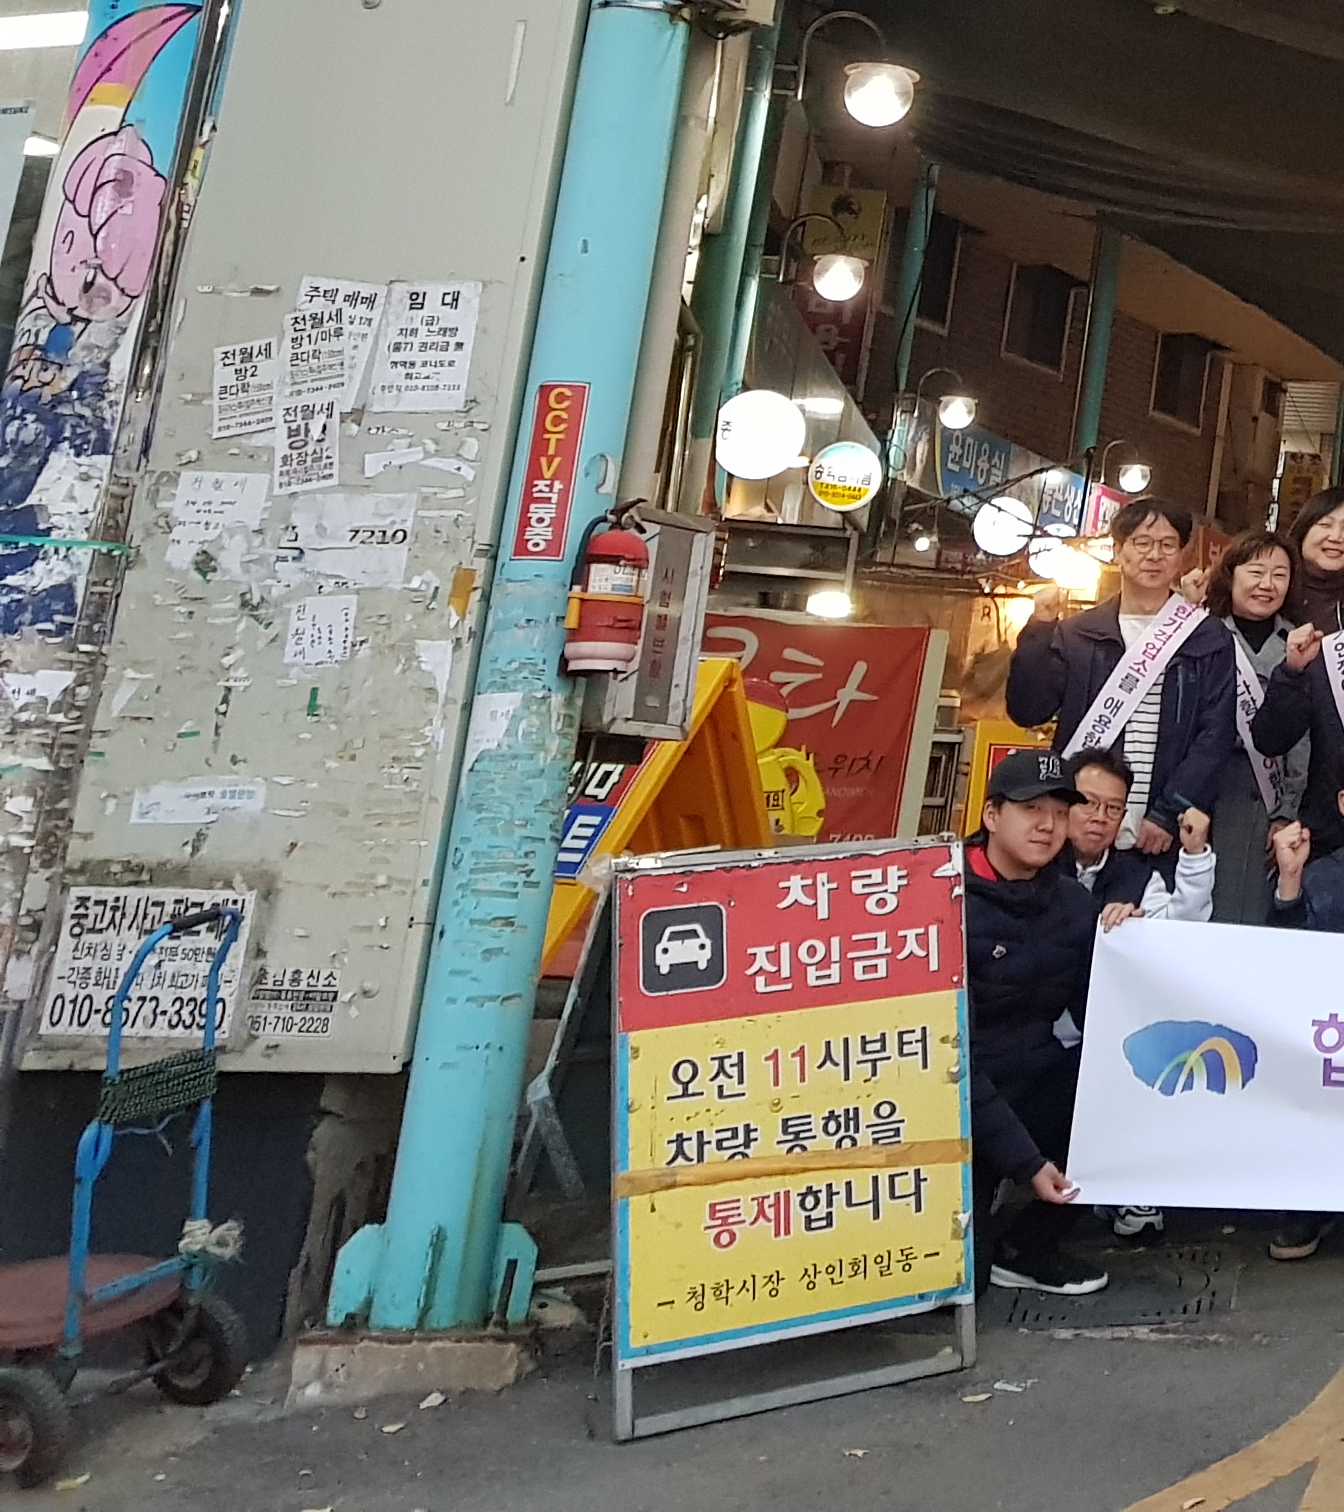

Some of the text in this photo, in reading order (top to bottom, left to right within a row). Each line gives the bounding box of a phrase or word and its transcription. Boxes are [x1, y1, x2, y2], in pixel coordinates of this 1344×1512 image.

[304, 285, 338, 305] 주택
[290, 307, 344, 334] 전월세
[220, 341, 273, 367] 전월세
[233, 365, 259, 380] 방2
[282, 400, 336, 425] 전월세
[348, 528, 409, 546] 7210
[1118, 600, 1199, 695] 한가격업소를
[69, 894, 128, 939] 중고차
[777, 866, 908, 922] 차량
[744, 922, 941, 994] 진입금지
[665, 1024, 931, 1102] 오전 11시부터
[664, 1096, 907, 1168] 차량 통행을
[702, 1168, 930, 1252] 통제합니다
